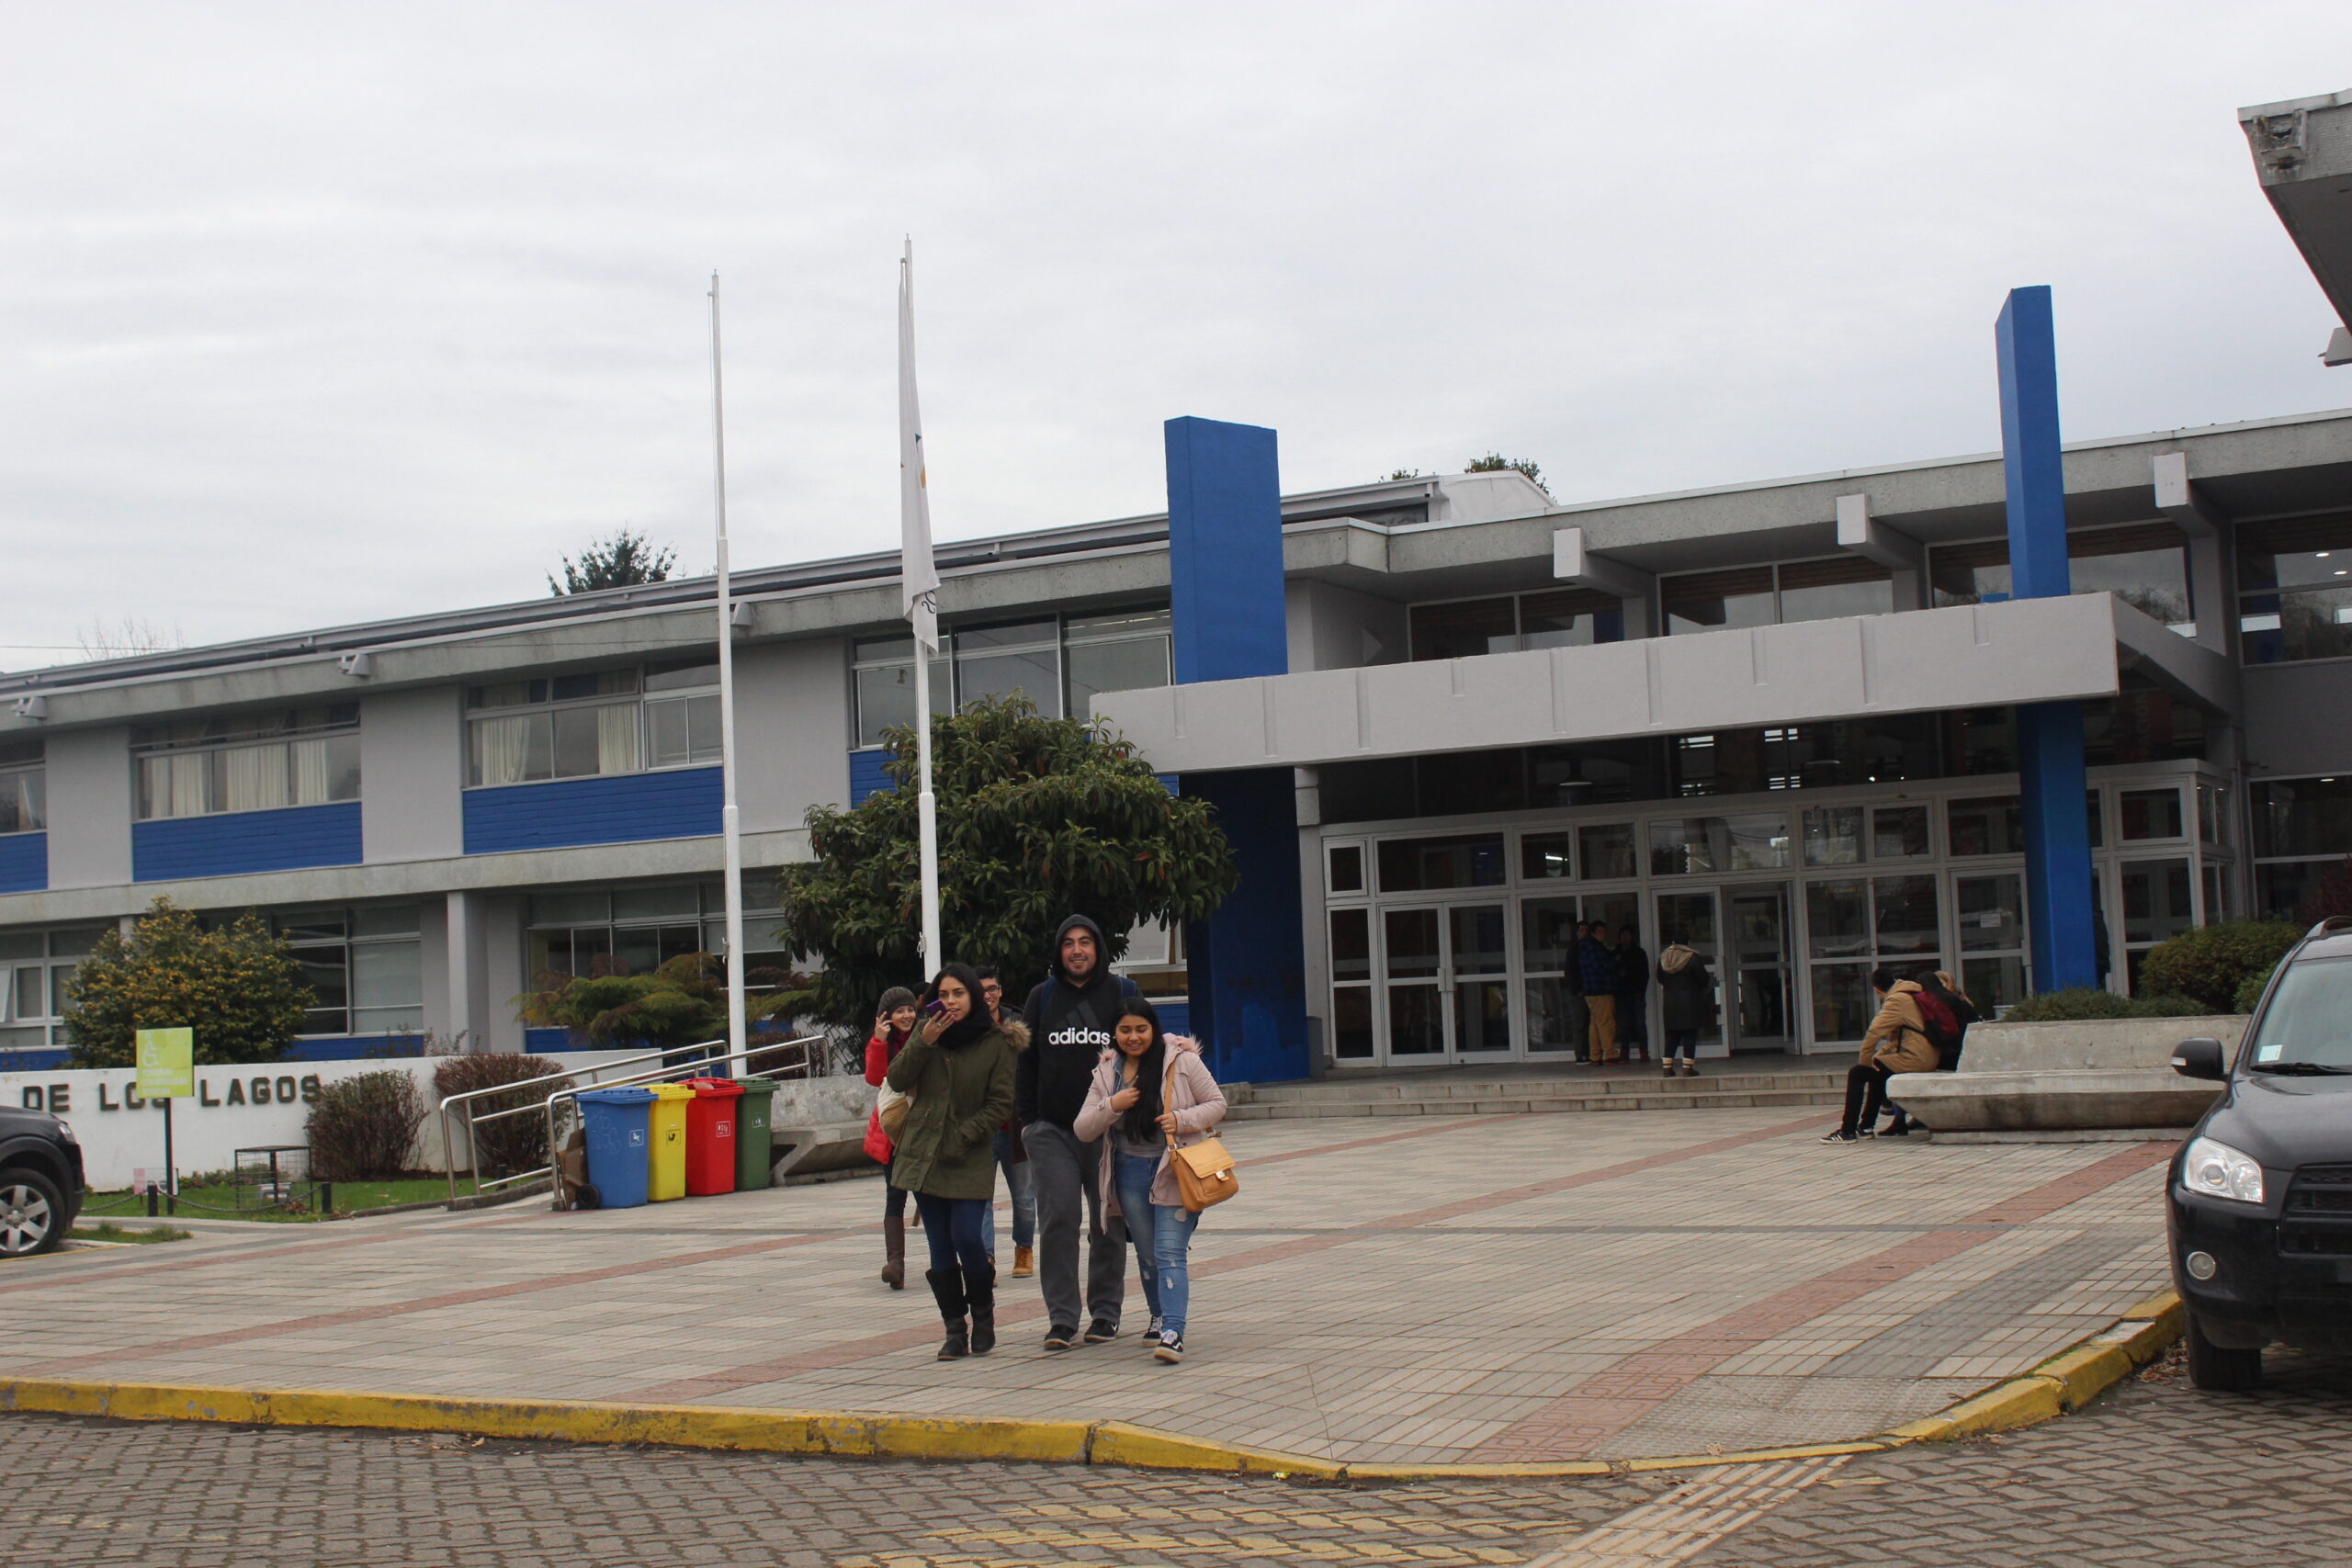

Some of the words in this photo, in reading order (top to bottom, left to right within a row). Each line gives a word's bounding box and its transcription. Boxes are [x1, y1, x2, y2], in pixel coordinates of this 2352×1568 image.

[1048, 1027, 1111, 1045] adidas
[23, 1084, 70, 1112] DE
[99, 1082, 165, 1111] LO
[200, 1075, 322, 1107] LAGOS
